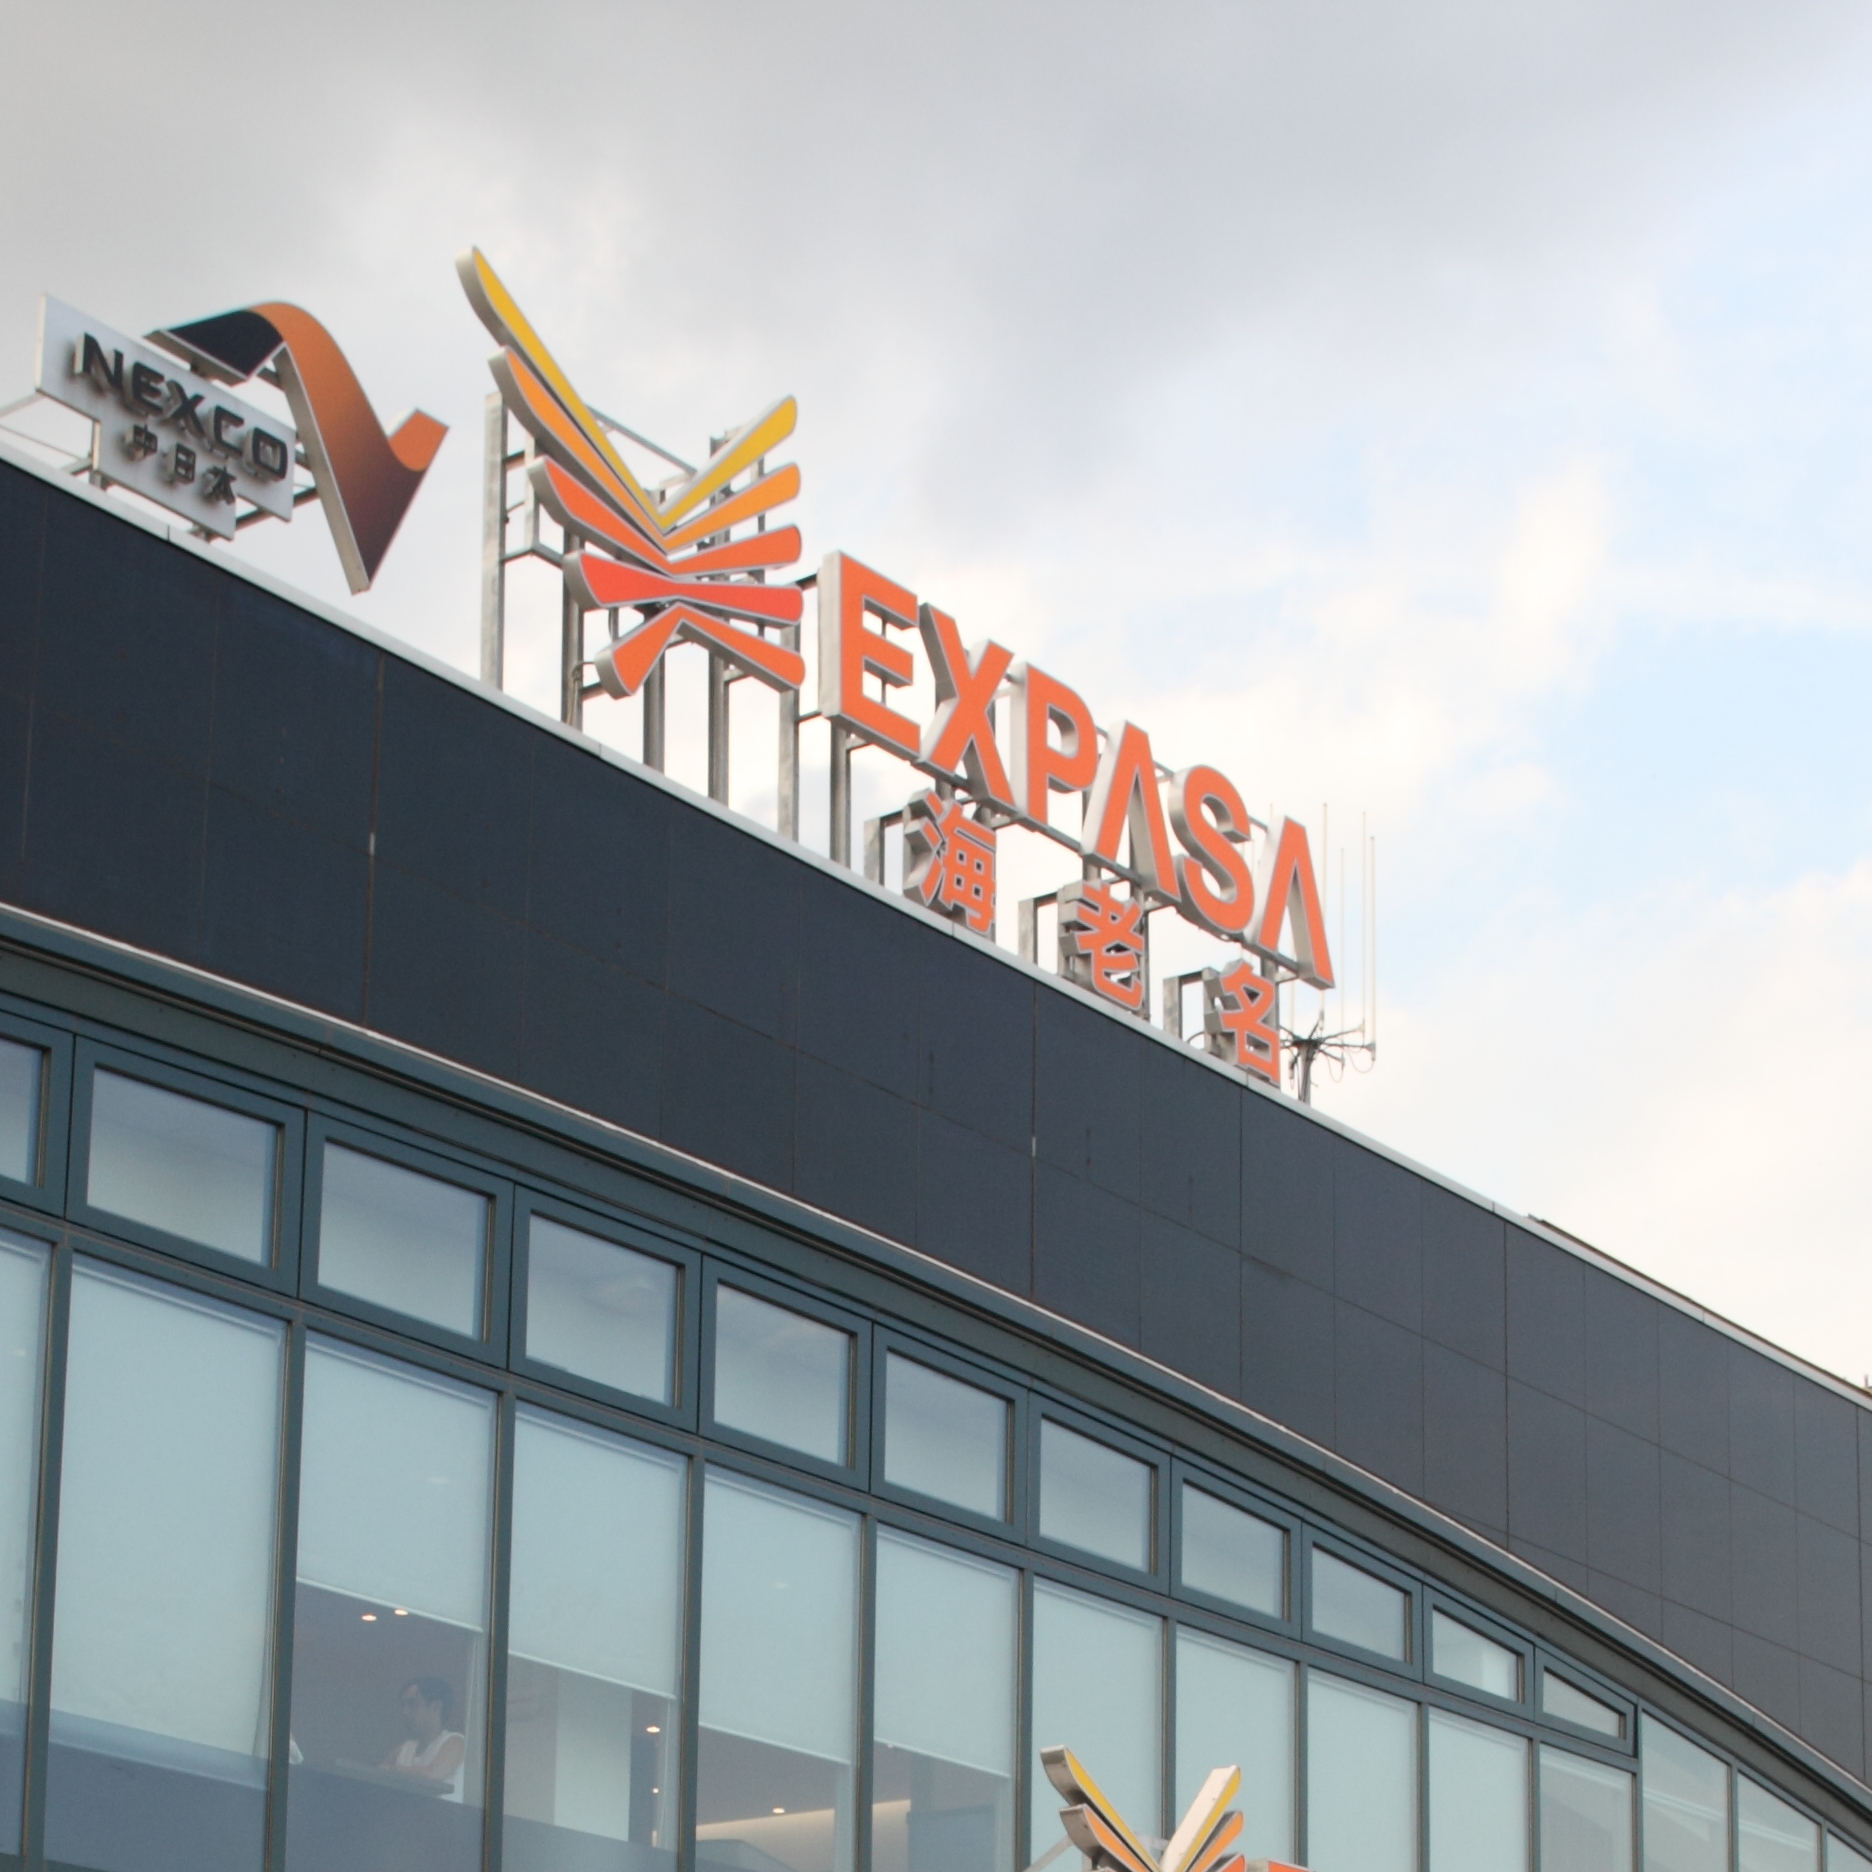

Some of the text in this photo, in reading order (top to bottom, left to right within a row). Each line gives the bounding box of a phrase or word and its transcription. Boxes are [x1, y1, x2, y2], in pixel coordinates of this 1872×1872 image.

[80, 331, 289, 482] NEXCO
[126, 422, 237, 506] 中日本
[820, 550, 1335, 990] EXPASA
[910, 796, 1282, 1083] 海老名
